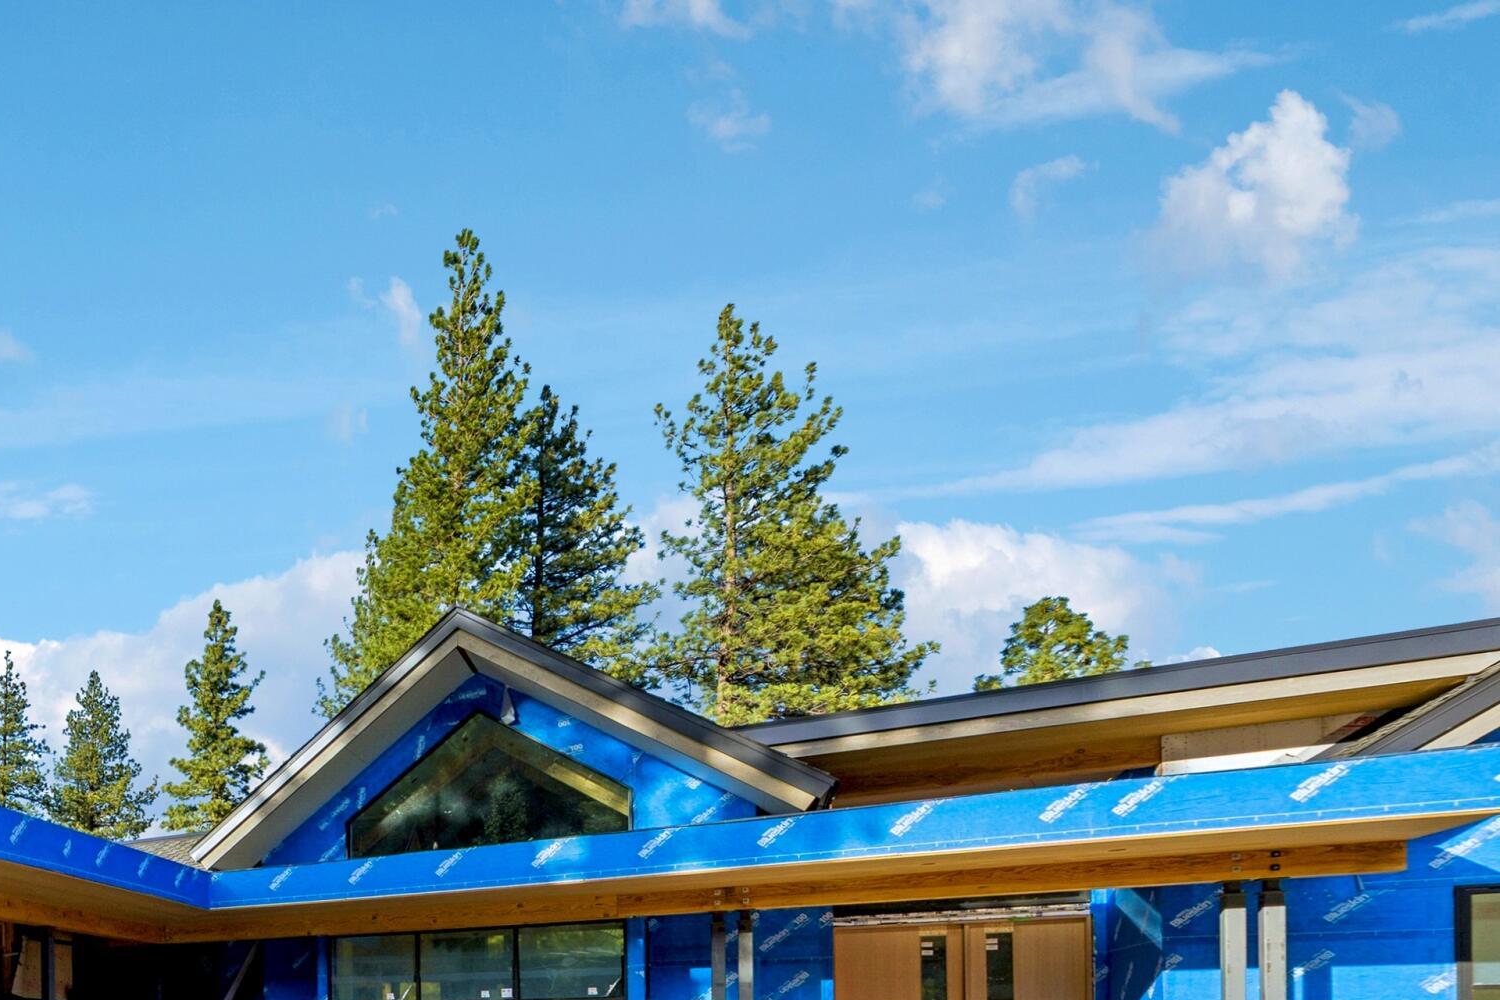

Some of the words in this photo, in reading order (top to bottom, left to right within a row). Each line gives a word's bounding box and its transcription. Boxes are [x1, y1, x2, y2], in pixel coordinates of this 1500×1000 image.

[1289, 764, 1345, 801] Blueskin
[1038, 789, 1085, 823] Blueskin
[1111, 780, 1161, 816] Blueskin
[757, 818, 793, 847] Blueskin
[889, 804, 930, 837] Blueskin
[637, 831, 671, 858] Blueskin
[435, 852, 461, 877] Blueskin
[1169, 900, 1212, 927] Blueskin
[1322, 894, 1369, 922] Blueskin
[759, 928, 789, 952] Blueskin
